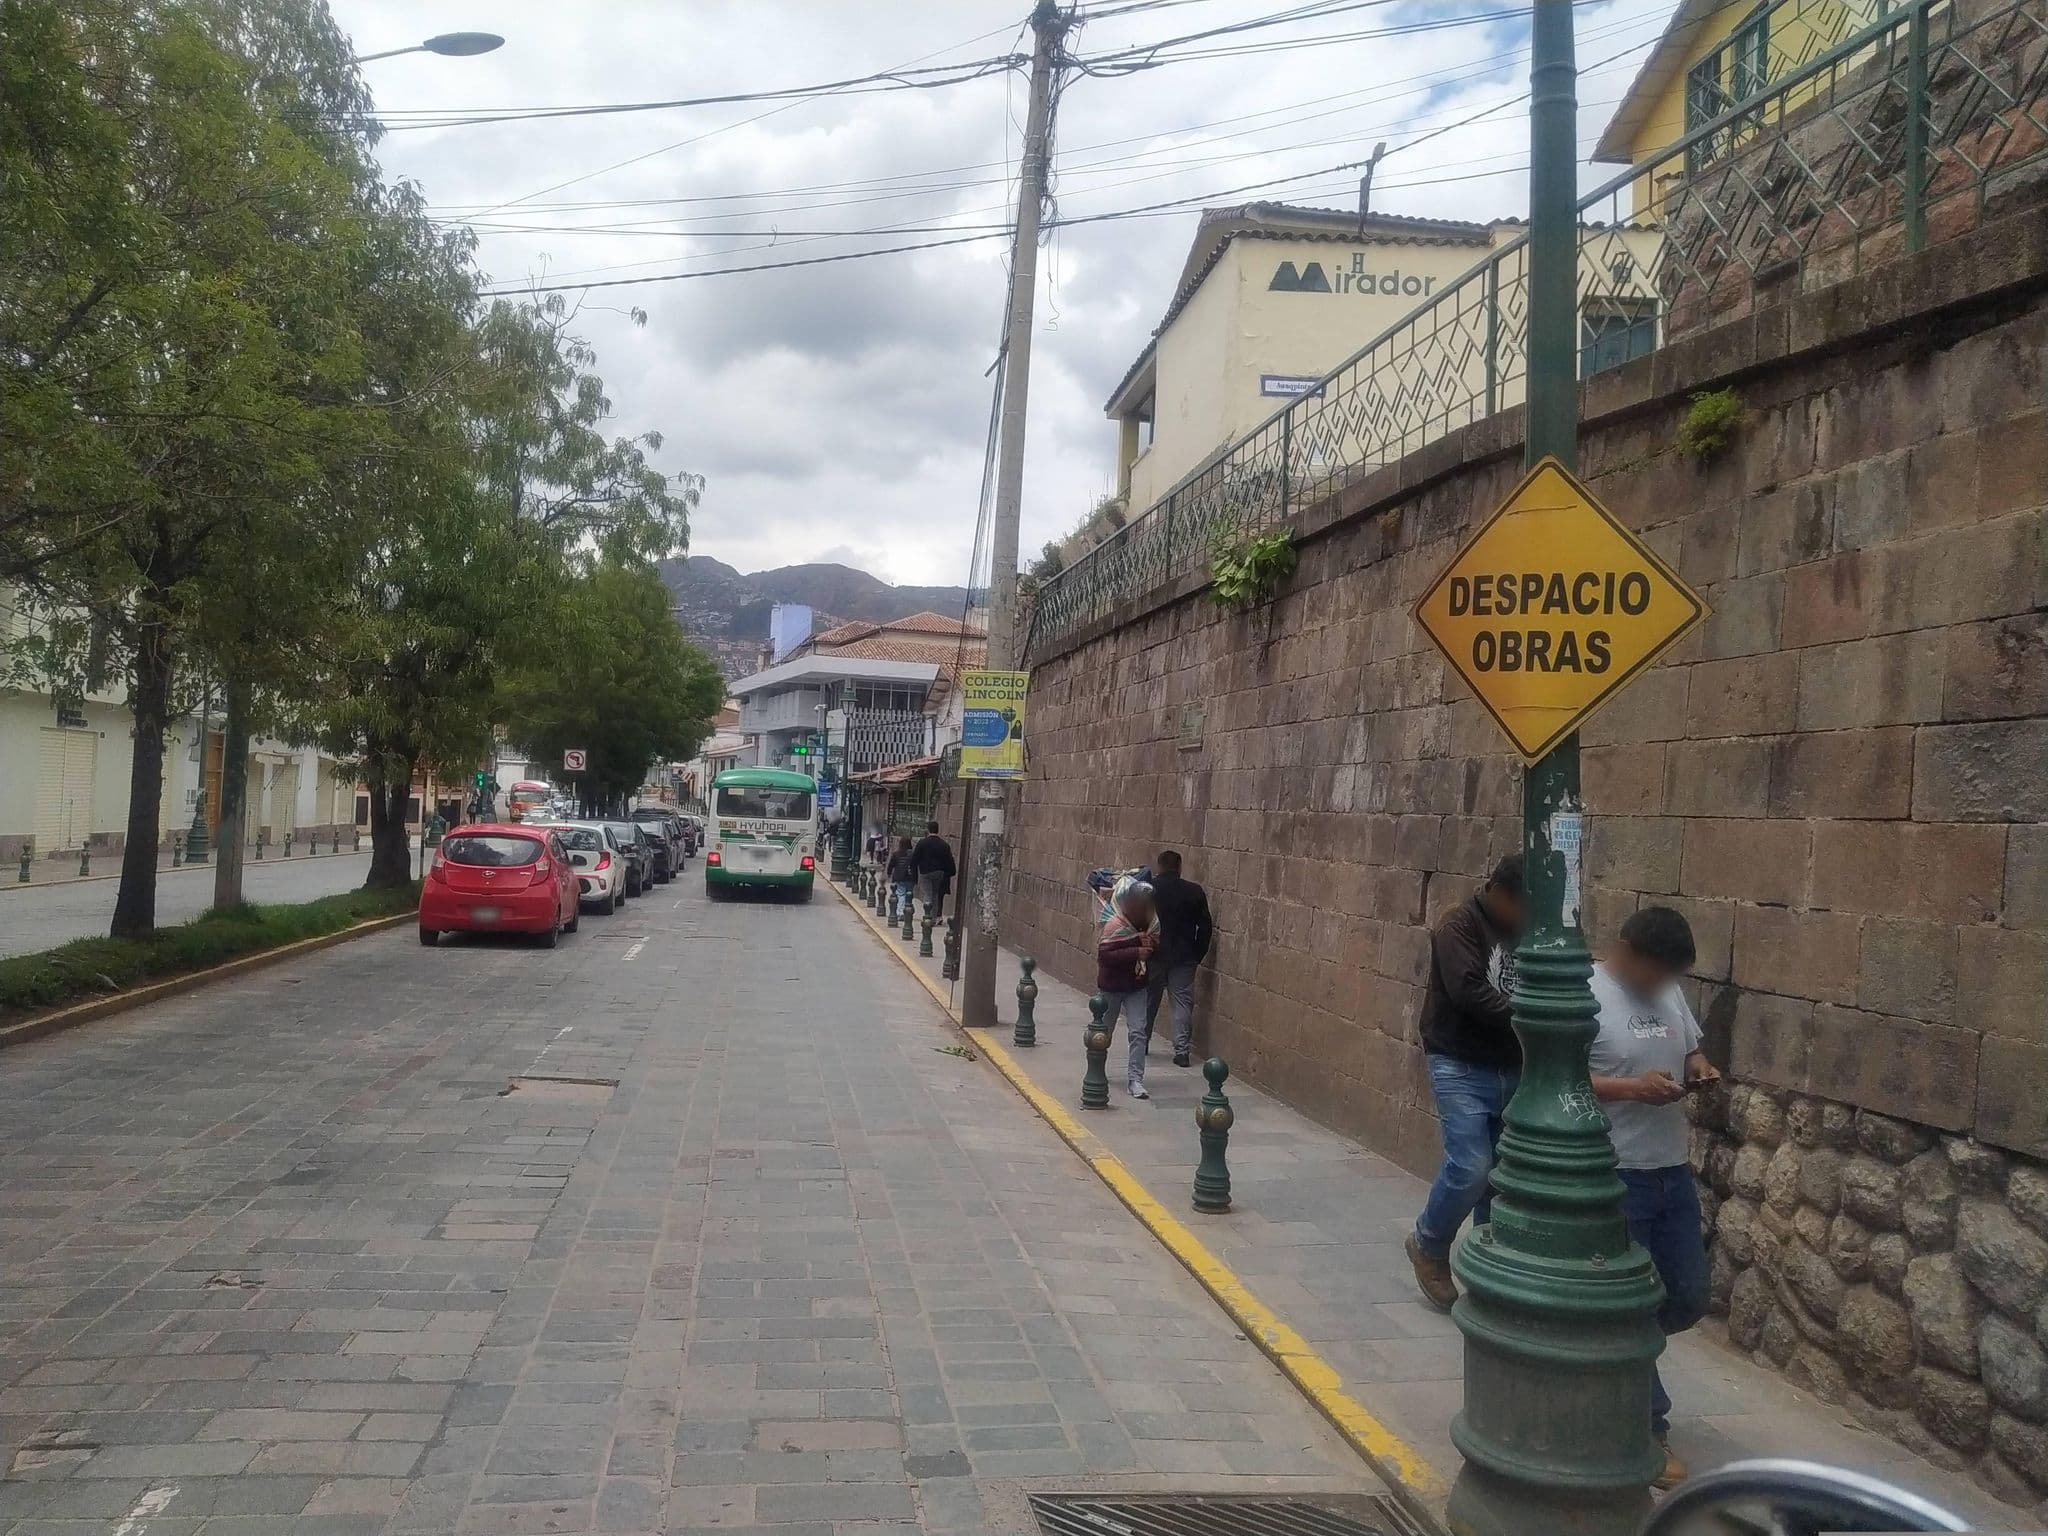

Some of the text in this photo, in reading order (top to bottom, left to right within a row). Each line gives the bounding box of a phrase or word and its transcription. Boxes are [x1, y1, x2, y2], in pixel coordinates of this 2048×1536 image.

[1448, 571, 1651, 617] DESPACIO
[1472, 630, 1611, 674] OBRAS
[965, 676, 1025, 688] COLEGIO
[965, 689, 1025, 701] LINCOLN
